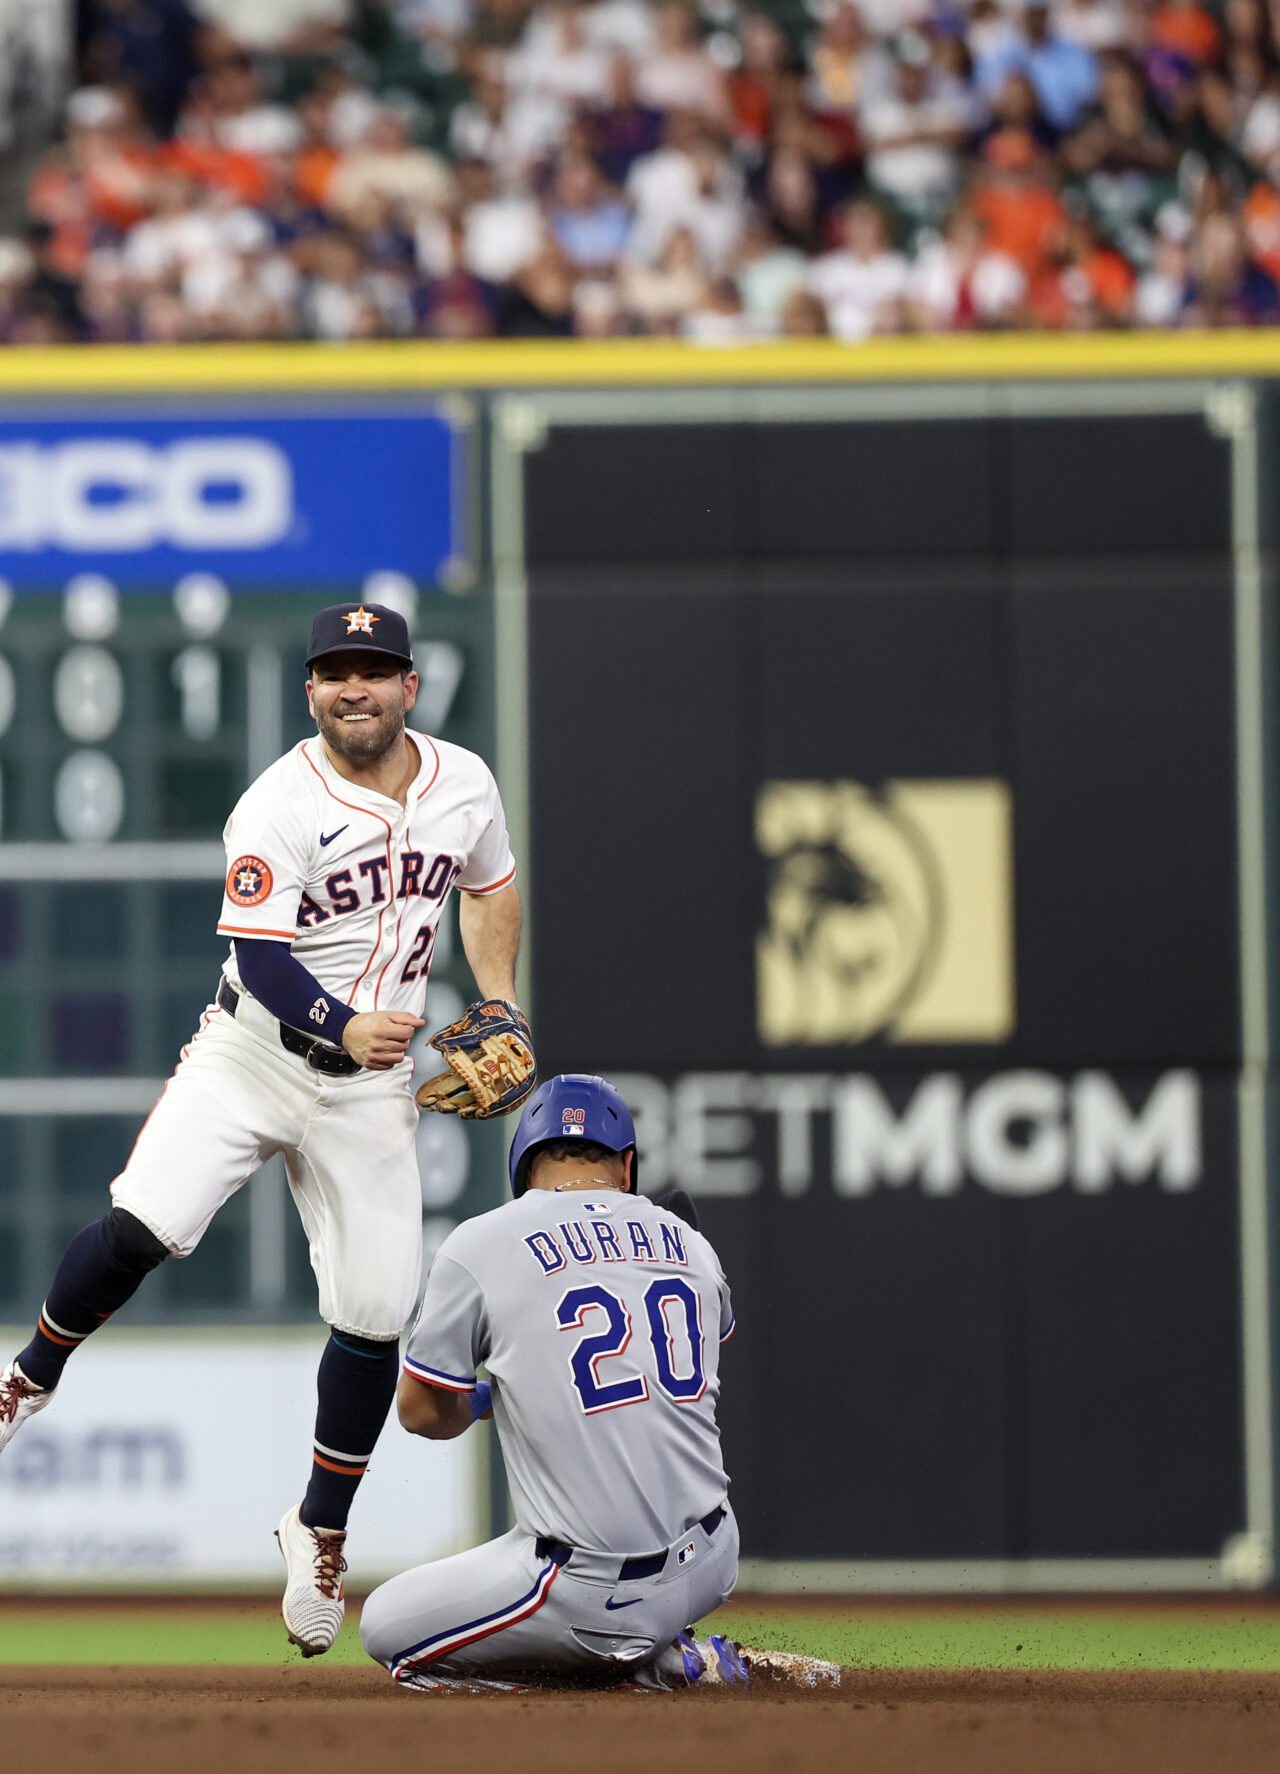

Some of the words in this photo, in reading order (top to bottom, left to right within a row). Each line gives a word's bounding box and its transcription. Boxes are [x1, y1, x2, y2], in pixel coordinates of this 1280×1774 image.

[54, 645, 123, 743] 0
[173, 646, 219, 741] 1
[55, 750, 123, 844] 0
[308, 997, 331, 1025] 27
[562, 1107, 586, 1123] 20
[521, 1221, 689, 1277] DURAN
[553, 1274, 708, 1416] 20
